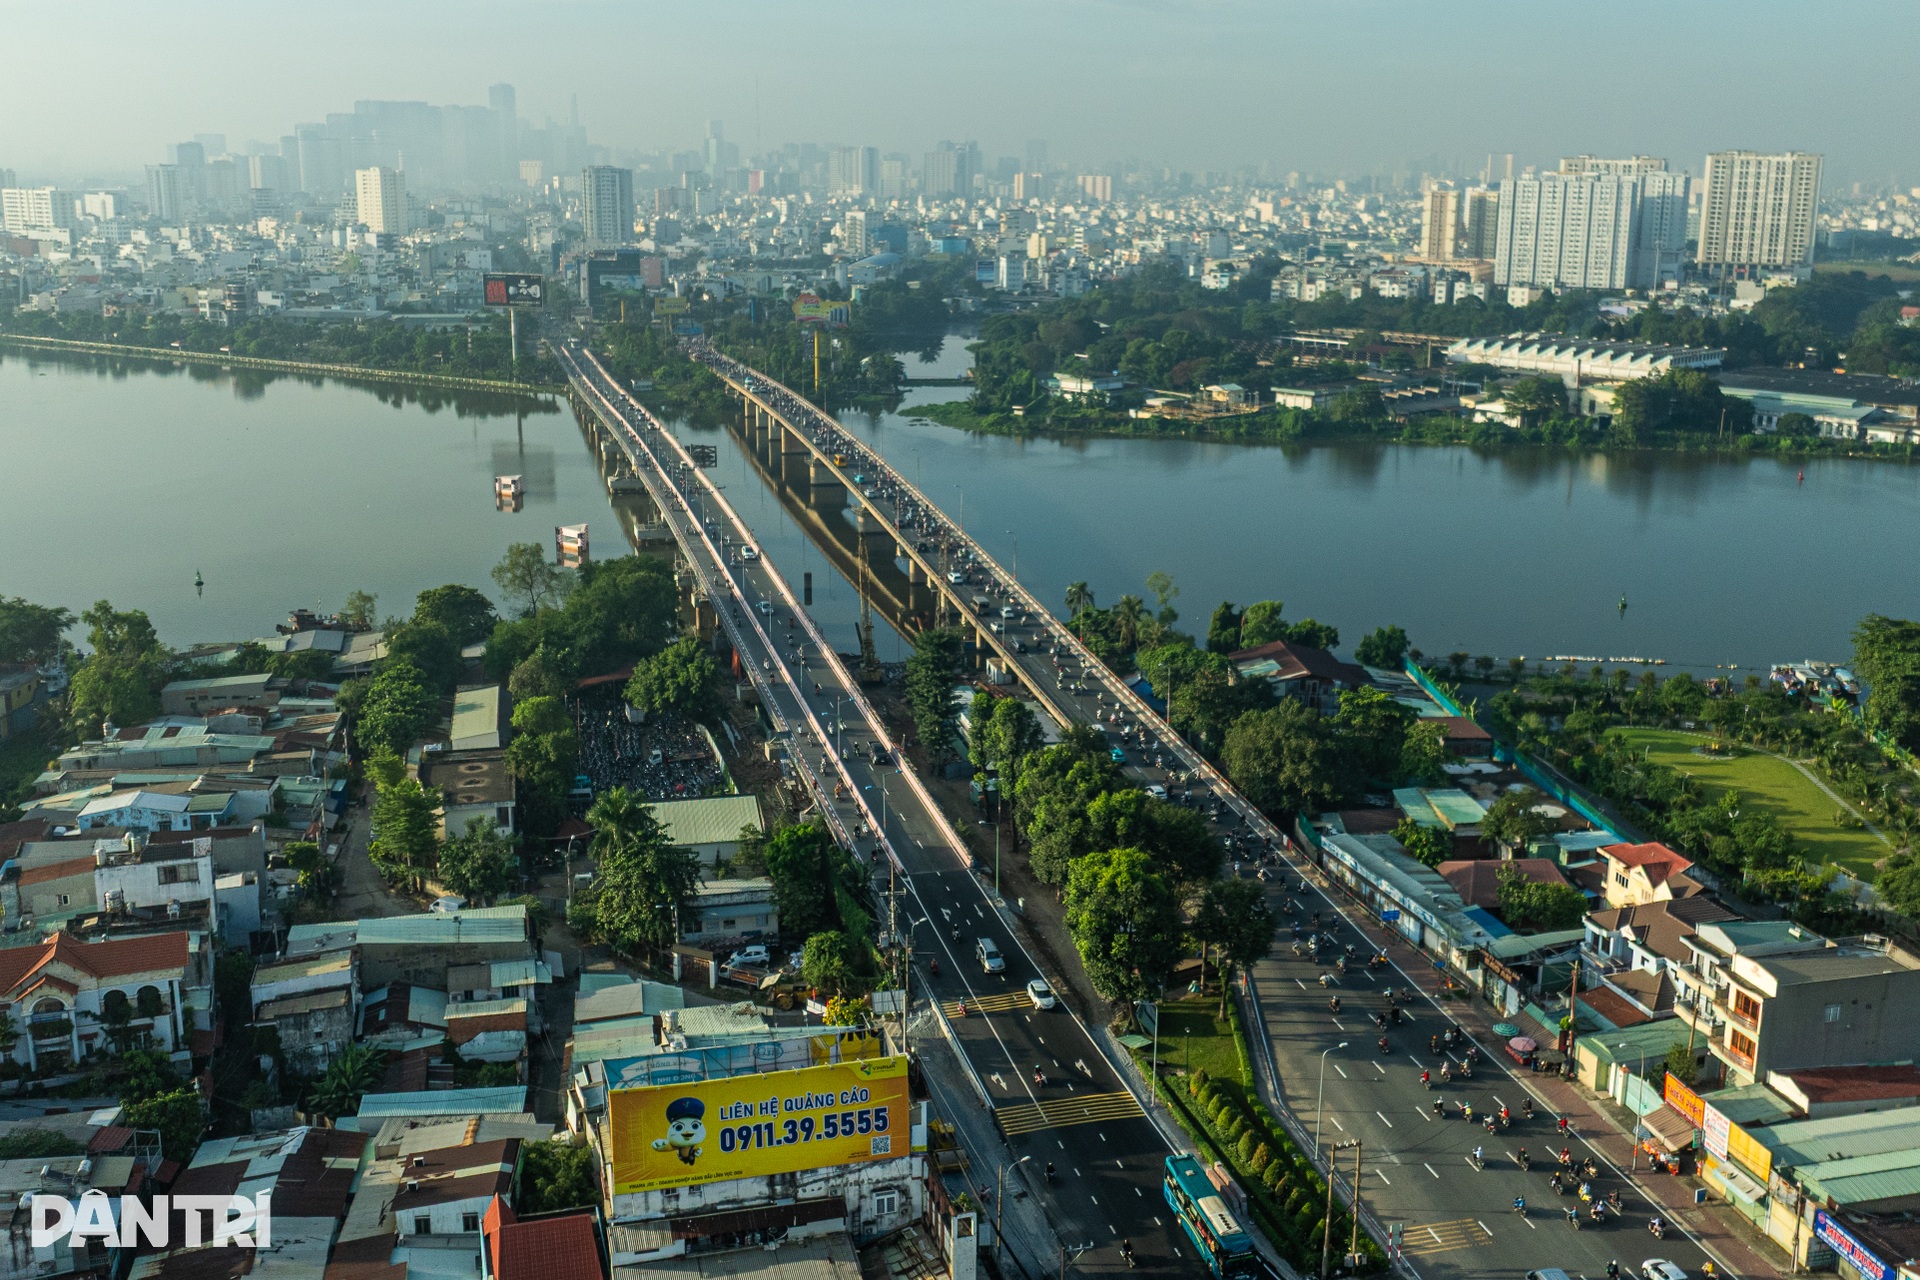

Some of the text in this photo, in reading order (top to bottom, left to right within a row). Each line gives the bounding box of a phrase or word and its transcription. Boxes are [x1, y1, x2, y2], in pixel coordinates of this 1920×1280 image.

[720, 1085, 869, 1121] LIÊN HỆ QUẢNG CÁO
[720, 1106, 889, 1153] 0911.39.5555
[1825, 1224, 1853, 1253] MINH
